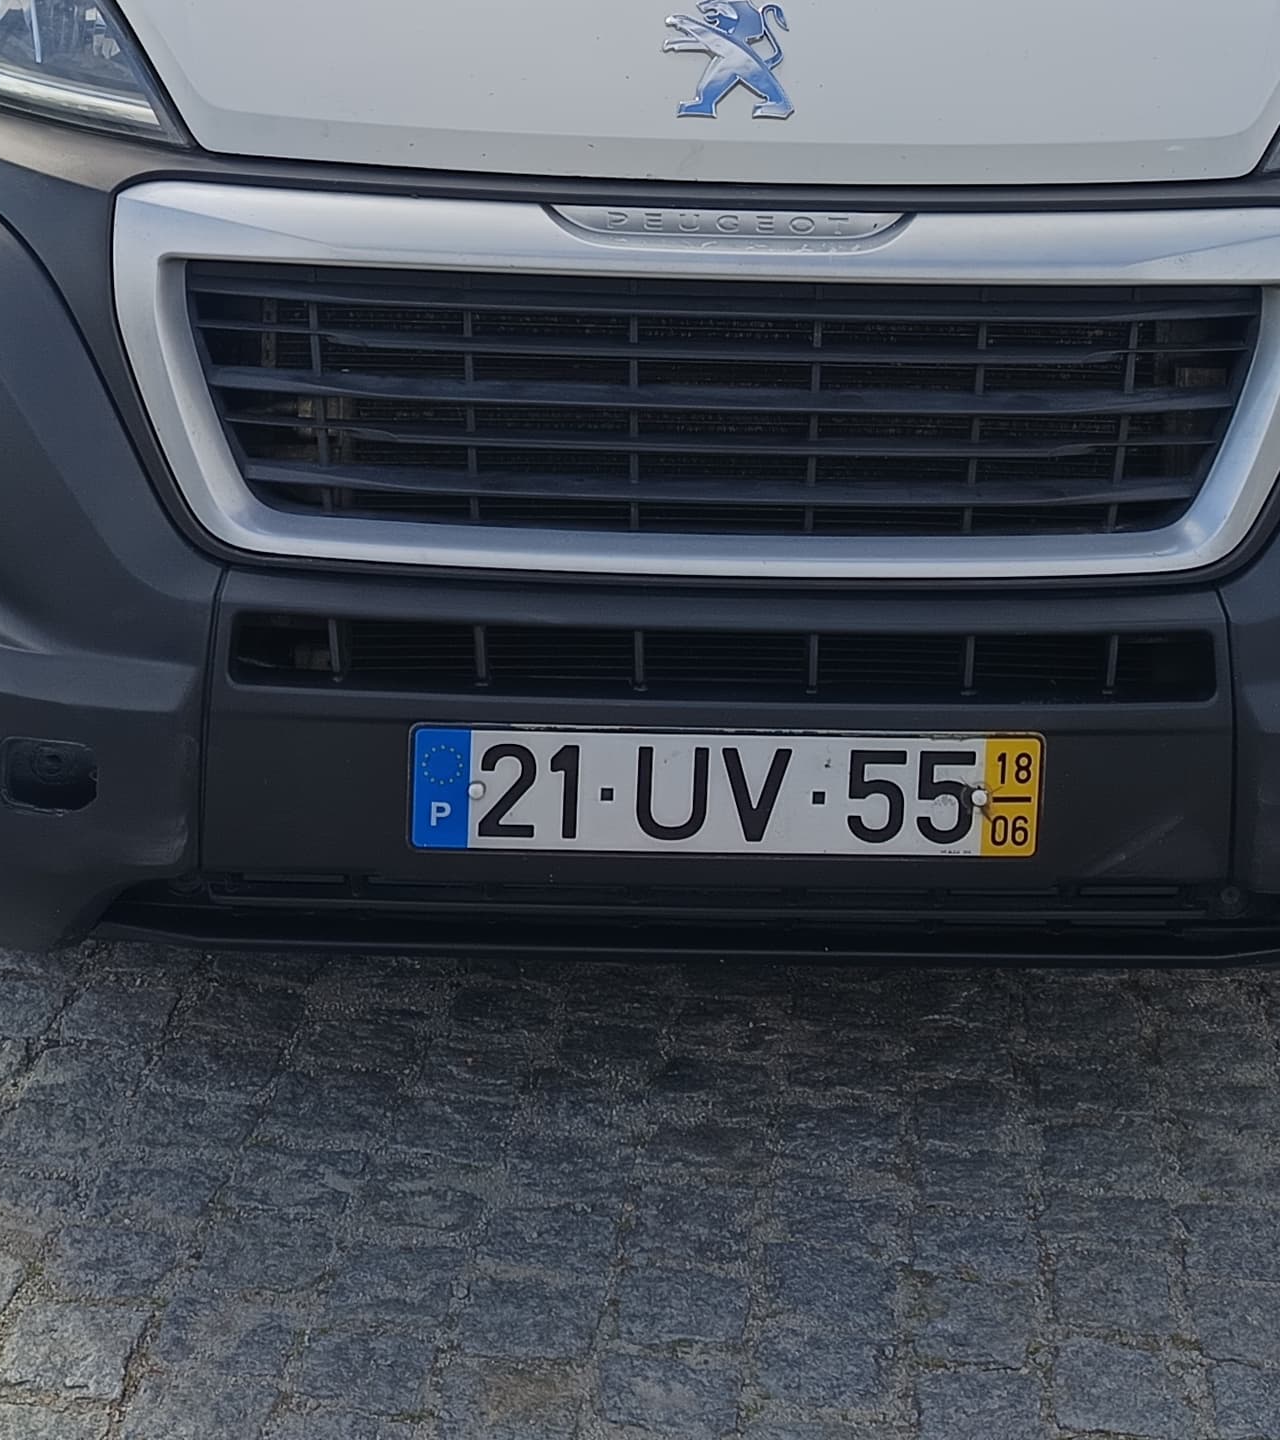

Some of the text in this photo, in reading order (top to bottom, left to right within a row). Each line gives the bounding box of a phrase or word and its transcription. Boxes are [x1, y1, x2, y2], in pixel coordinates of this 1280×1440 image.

[606, 210, 849, 236] PEUGEOT
[997, 751, 1033, 785] 18
[429, 801, 451, 827] P
[990, 814, 1029, 847] 06
